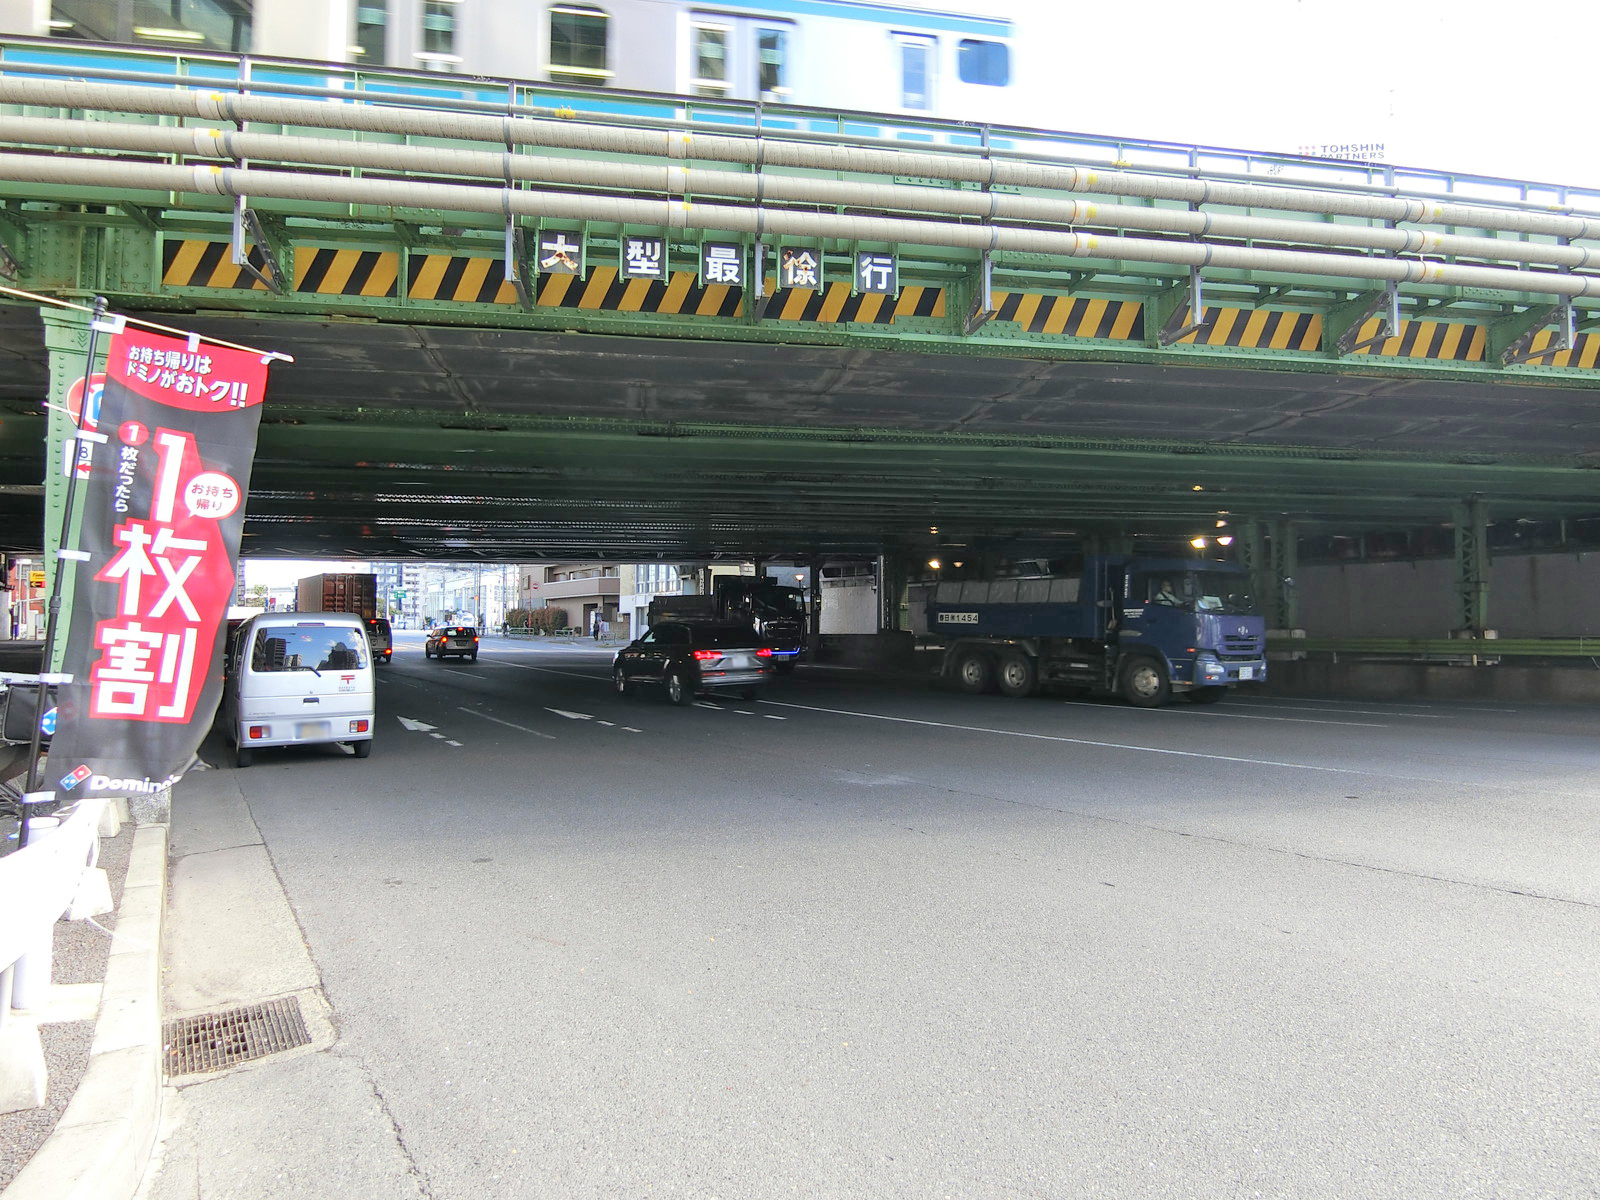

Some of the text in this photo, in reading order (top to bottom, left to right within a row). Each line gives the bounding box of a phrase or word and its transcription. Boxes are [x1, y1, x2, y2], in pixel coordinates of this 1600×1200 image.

[1320, 143, 1385, 153] TOHSHIN
[540, 234, 893, 290] 大型最徐行
[128, 346, 212, 375] お持ち帰りは
[126, 361, 249, 408] ドミノがおトク!!
[191, 483, 234, 498] お持ち
[195, 498, 223, 511] 帰り
[96, 432, 208, 718] 1枚割
